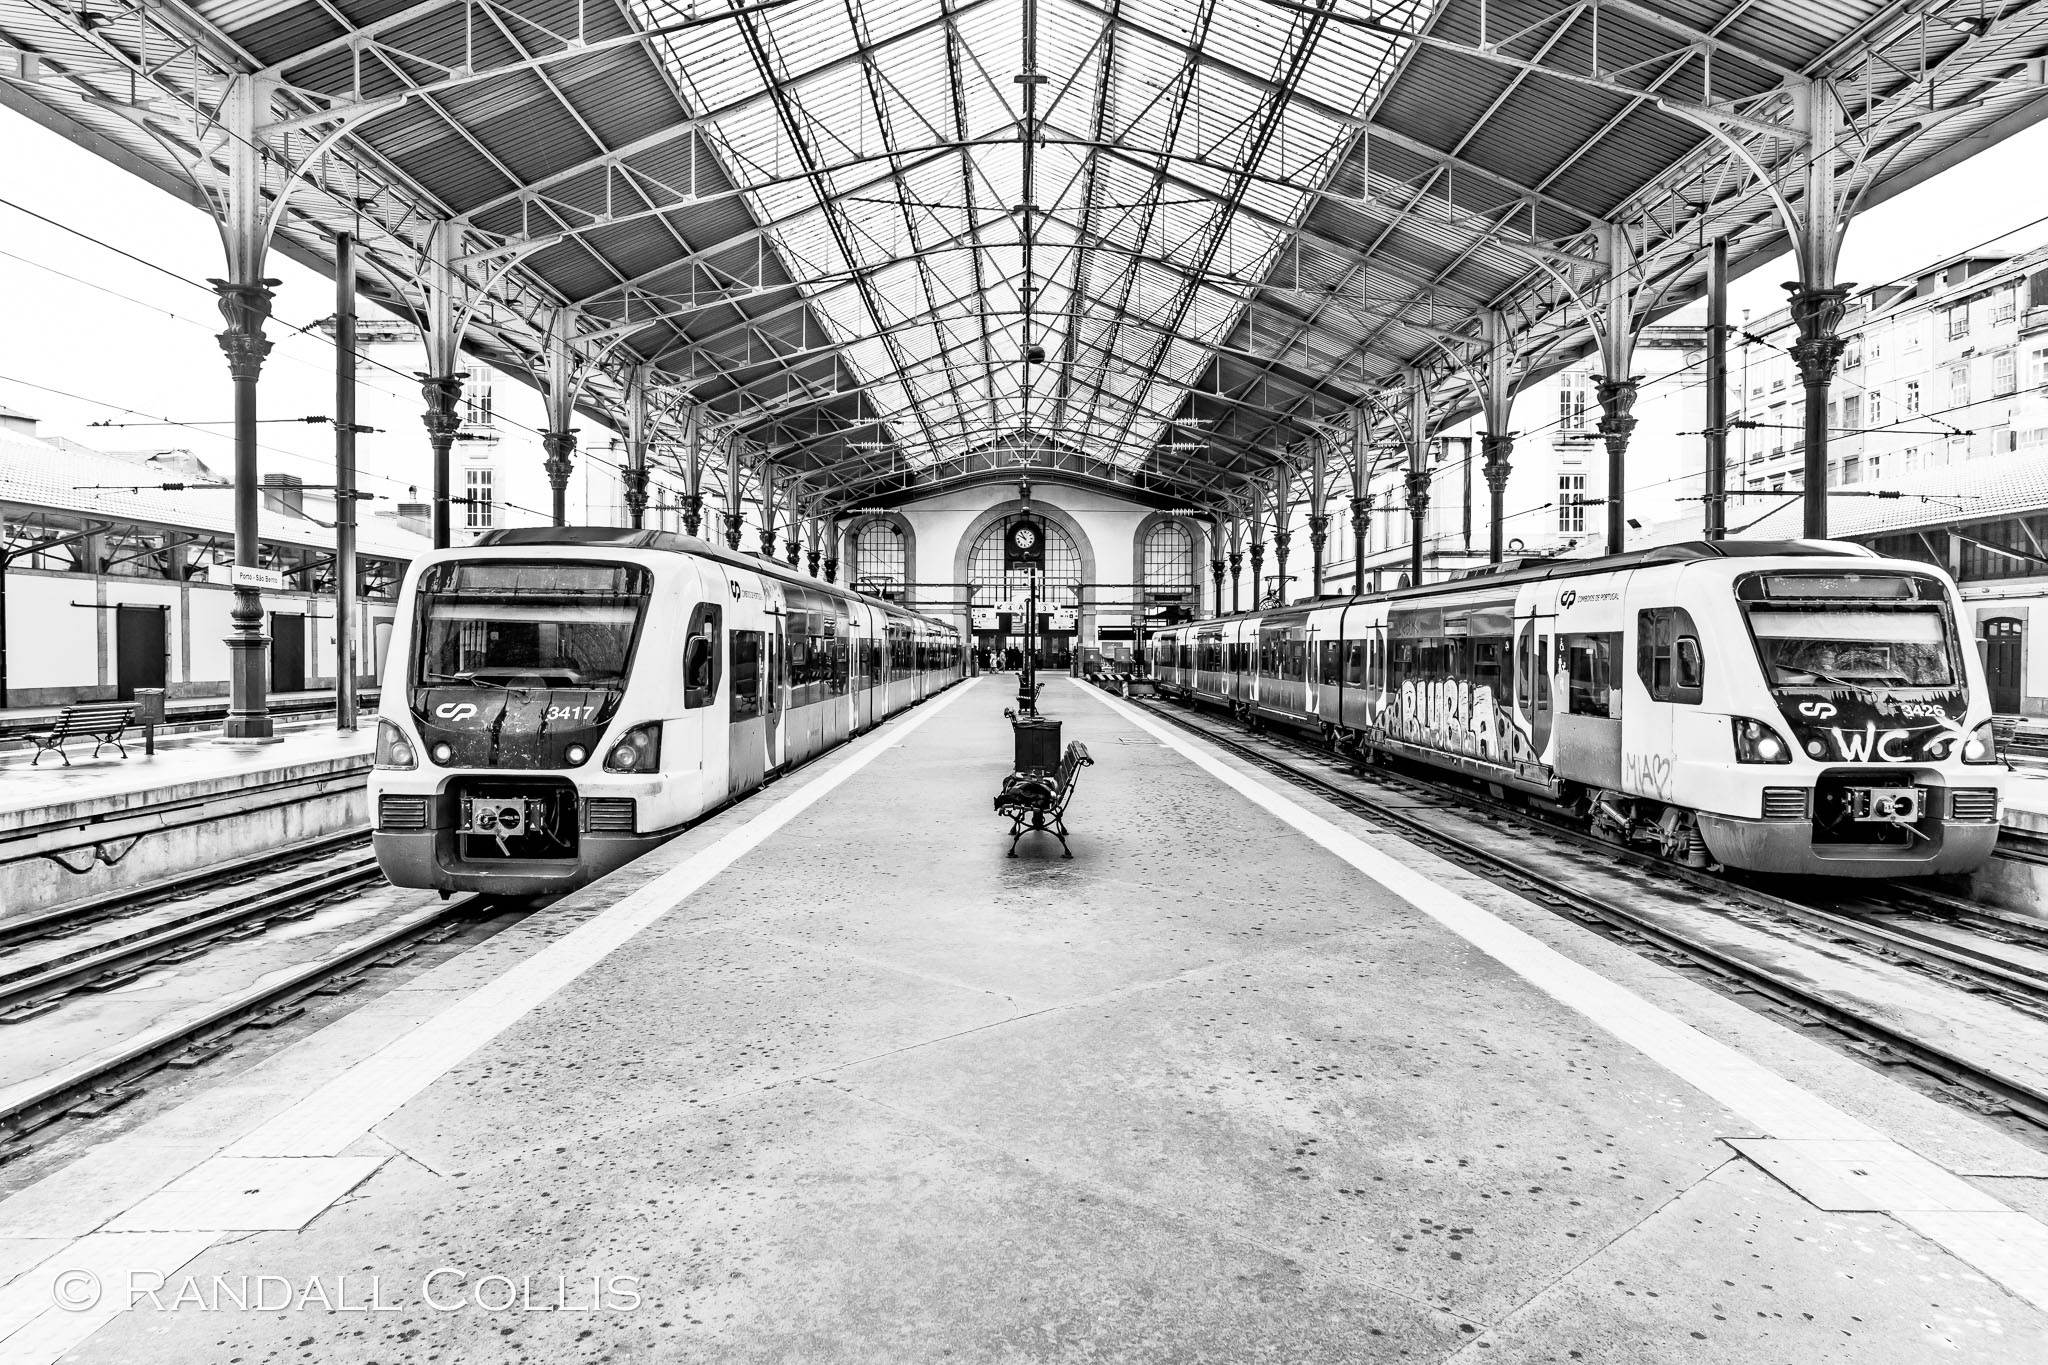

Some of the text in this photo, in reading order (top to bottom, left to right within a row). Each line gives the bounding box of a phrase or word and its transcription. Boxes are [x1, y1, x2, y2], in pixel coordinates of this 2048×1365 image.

[240, 572, 252, 580] Porto
[547, 706, 594, 720] 3417
[1902, 704, 1946, 717] 3426
[1831, 720, 1913, 763] WC
